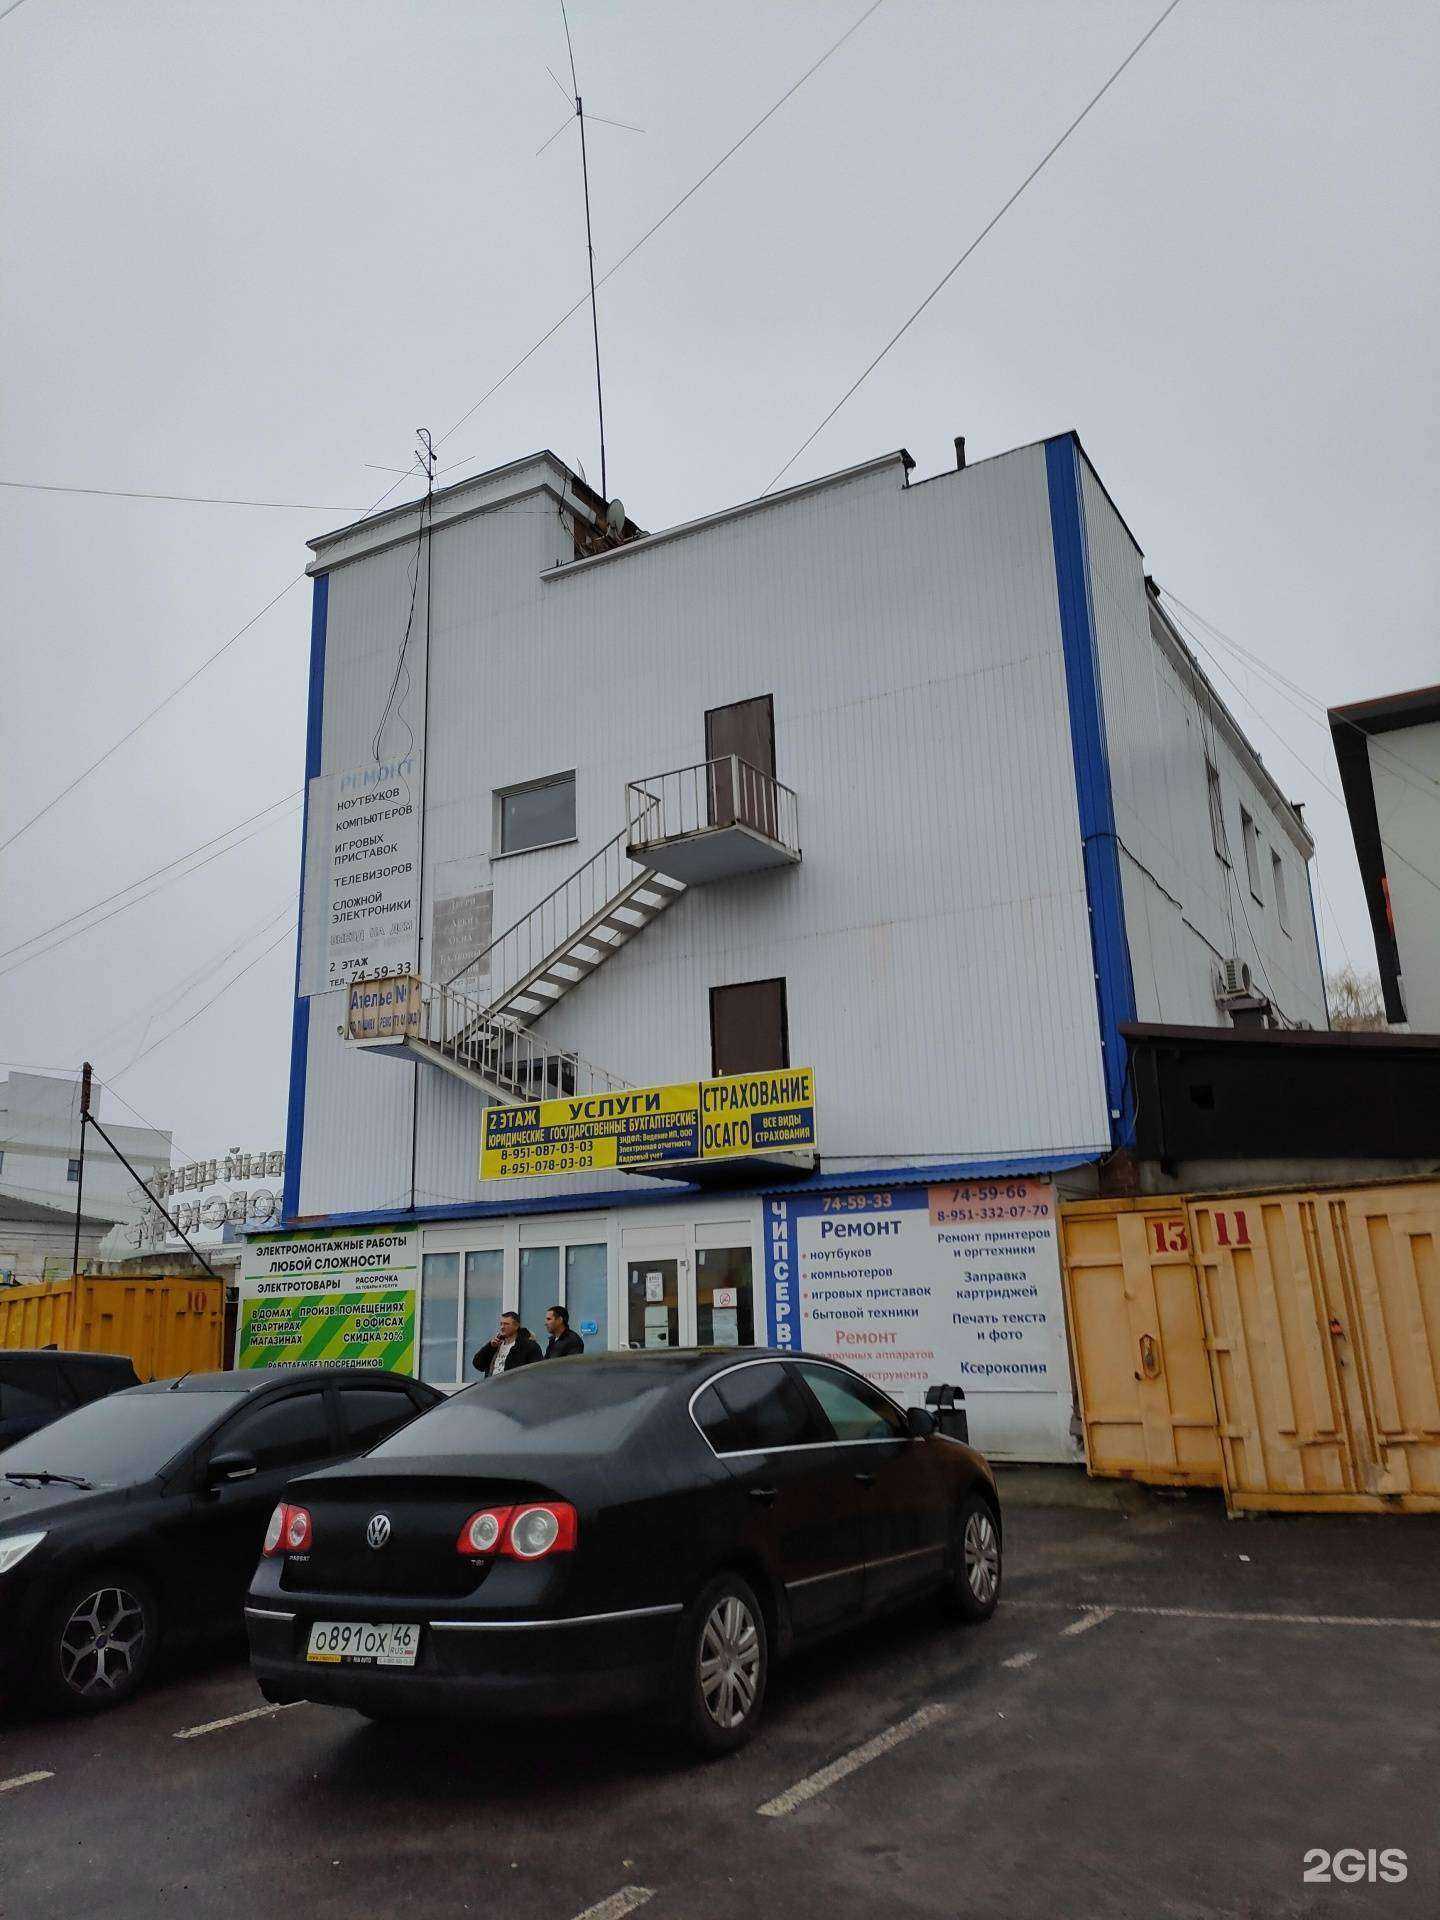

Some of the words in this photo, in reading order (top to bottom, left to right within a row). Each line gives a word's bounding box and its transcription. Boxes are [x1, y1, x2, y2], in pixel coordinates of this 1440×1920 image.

[337, 788, 399, 811] НОУТБУКОВ
[336, 805, 412, 831] КОМПЬЮТЕРОВ
[335, 834, 384, 853] ИГРОВЫХ
[334, 842, 398, 865] ПРИСТАВОК
[334, 863, 412, 887] ТЕЛЕВИЗОРОВ
[332, 892, 382, 910] СЛОЖНОЙ
[332, 899, 411, 924] ЭЛЕКТРОНИКИ
[329, 962, 336, 972] 2
[341, 957, 368, 970] ЭТАЖ
[329, 978, 348, 987] ТЕЛ.
[351, 962, 411, 982] 74-59-33
[703, 1075, 810, 1112] СТРАХОВАНИЕ
[568, 1092, 661, 1120] УСЛУГИ
[489, 1114, 497, 1129] 2
[499, 1109, 537, 1128] ЭТАЖ
[762, 1116, 777, 1128] ВСЕ
[778, 1114, 801, 1127] ВИДЫ
[488, 1129, 545, 1148] ЮРИДИЧЕСКИЕ
[549, 1119, 627, 1141] ГОСУДАРСТВЕННЫЕ
[629, 1111, 697, 1132] БУХГАЛТЕРСКИЕ
[704, 1119, 750, 1149] ОСАГО
[755, 1127, 810, 1142] СТРАХОВАНИЯ
[501, 1141, 593, 1160] 8-951-087-03-03
[500, 1156, 593, 1175] 8-951-078-03-03
[952, 1184, 1027, 1202] 74-59-66
[822, 1193, 893, 1212] 74-59-33
[937, 1204, 1049, 1221] 8-951-332-07-70
[820, 1220, 902, 1239] Ремонт
[937, 1232, 981, 1243] Ремонт
[985, 1229, 1051, 1243] принтеров
[1214, 1211, 1251, 1245] 11
[1153, 1221, 1188, 1252] 13
[256, 1239, 364, 1257] ЭЛЕКТРОМОНТАЖНЫЕ
[365, 1236, 407, 1249] РАБОТЫ
[810, 1247, 872, 1262] ноутбуков
[953, 1249, 961, 1258] и
[964, 1245, 1036, 1259] оргтехники
[269, 1257, 312, 1273] ЛЮБОЙ
[314, 1254, 391, 1270] СЛОЖНОСТИ
[355, 1275, 398, 1284] РАССРОЧКА
[811, 1267, 893, 1281] компьютеров
[964, 1271, 1027, 1284] Заправка
[257, 1280, 341, 1293] ЭЛЕКТРОТОВАРЫ
[811, 1290, 863, 1301] игровых
[866, 1287, 932, 1300] приставок
[956, 1285, 1038, 1300] картриджей
[258, 1308, 292, 1319] ДОМАХ
[339, 1303, 405, 1315] ПОМЕЩЕНИЯХ
[812, 1308, 864, 1320] бытовой
[867, 1308, 919, 1319] техники
[363, 1317, 404, 1327] ОФИСАХ
[952, 1312, 999, 1324] Печать
[1002, 1312, 1047, 1323] текста
[251, 1321, 301, 1332] КВАРТИРАХ
[251, 1335, 302, 1346] МАГАЗИНАХ
[343, 1333, 382, 1343] СКИДКА
[835, 1329, 897, 1345] Ремонт
[977, 1332, 985, 1340] и
[988, 1329, 1023, 1342] фото
[875, 1350, 935, 1361] аппаратов
[960, 1361, 1047, 1376] Ксерокопия
[394, 1626, 412, 1647] 46
[390, 1647, 404, 1655] RUS
